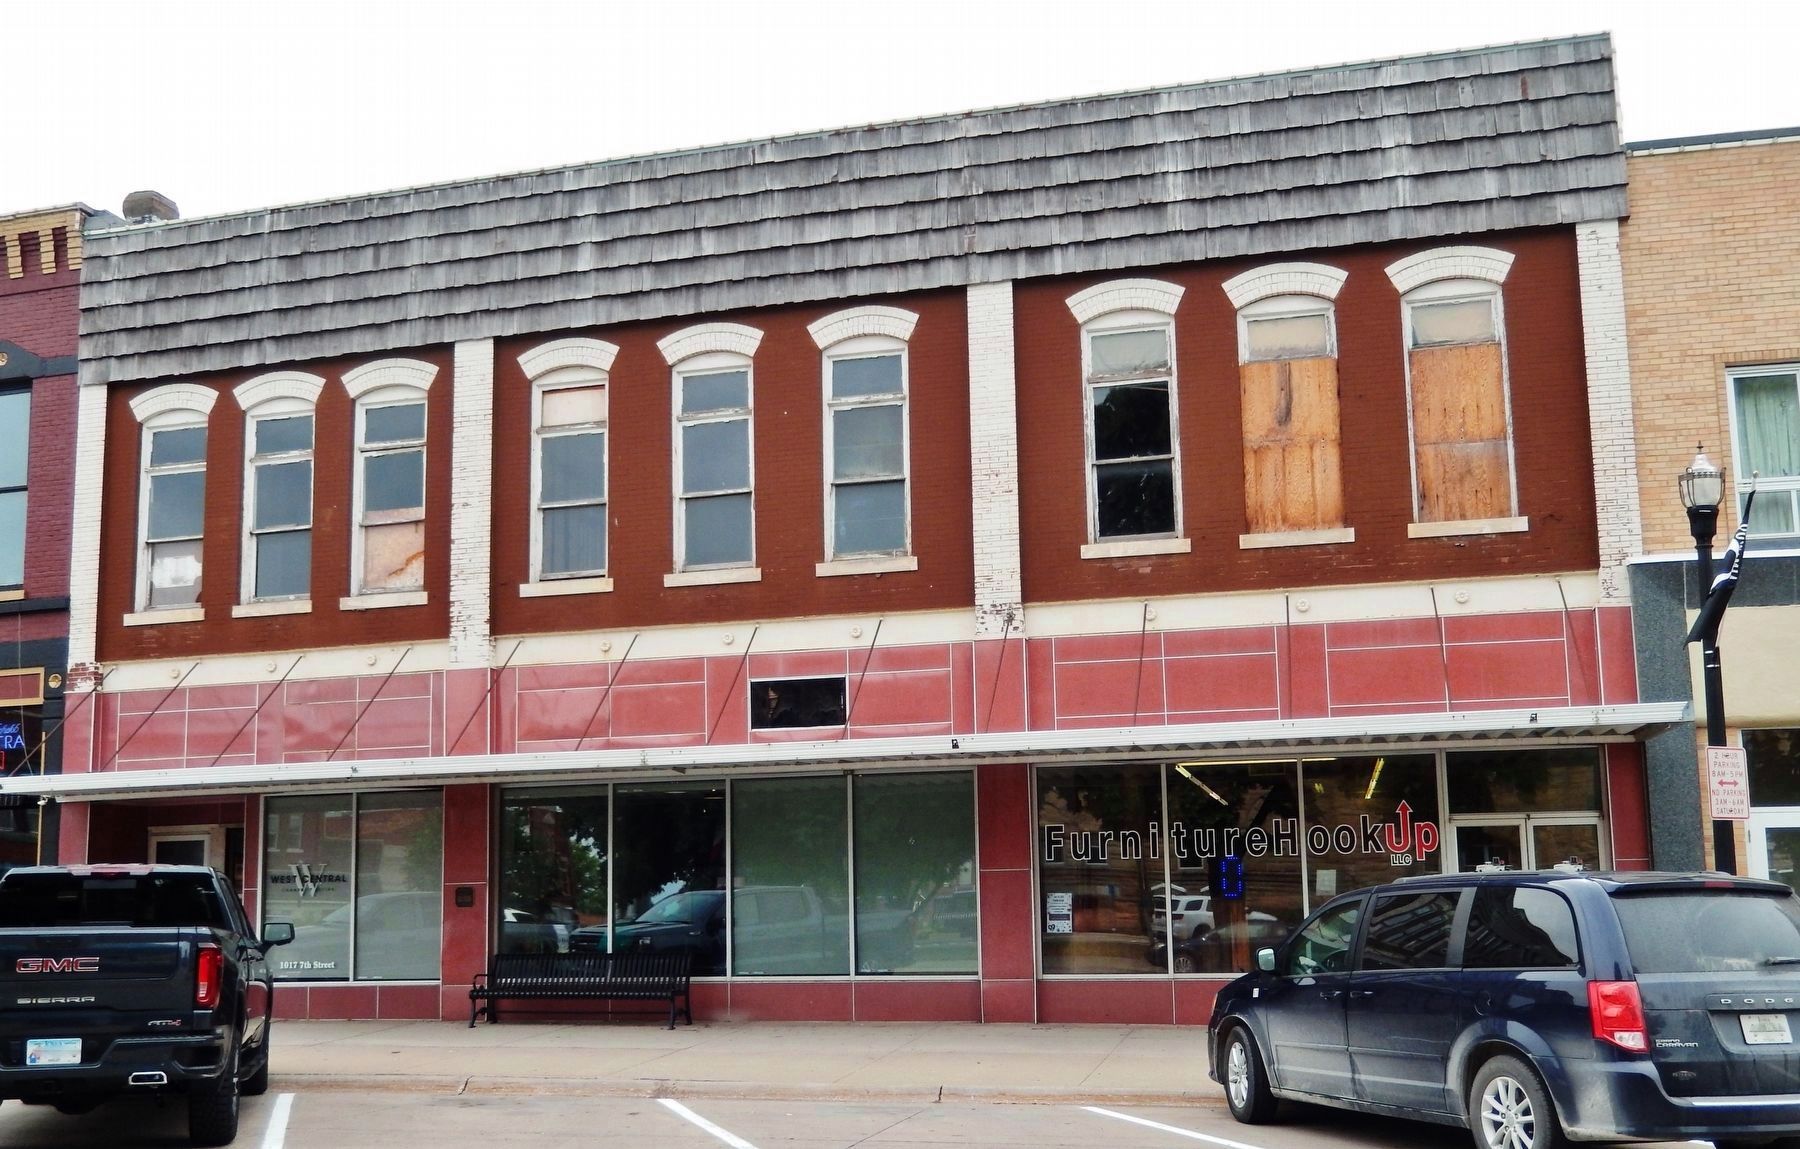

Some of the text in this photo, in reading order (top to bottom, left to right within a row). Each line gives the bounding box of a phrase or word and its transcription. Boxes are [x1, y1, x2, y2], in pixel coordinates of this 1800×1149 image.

[0, 735, 25, 749] RA
[1711, 789, 1746, 797] NO PARKING
[1390, 853, 1412, 866] LLC
[270, 874, 298, 884] WEST
[16, 957, 100, 973] GMC
[280, 961, 335, 969] 1017 7th Street
[17, 996, 96, 1004] SIERRA
